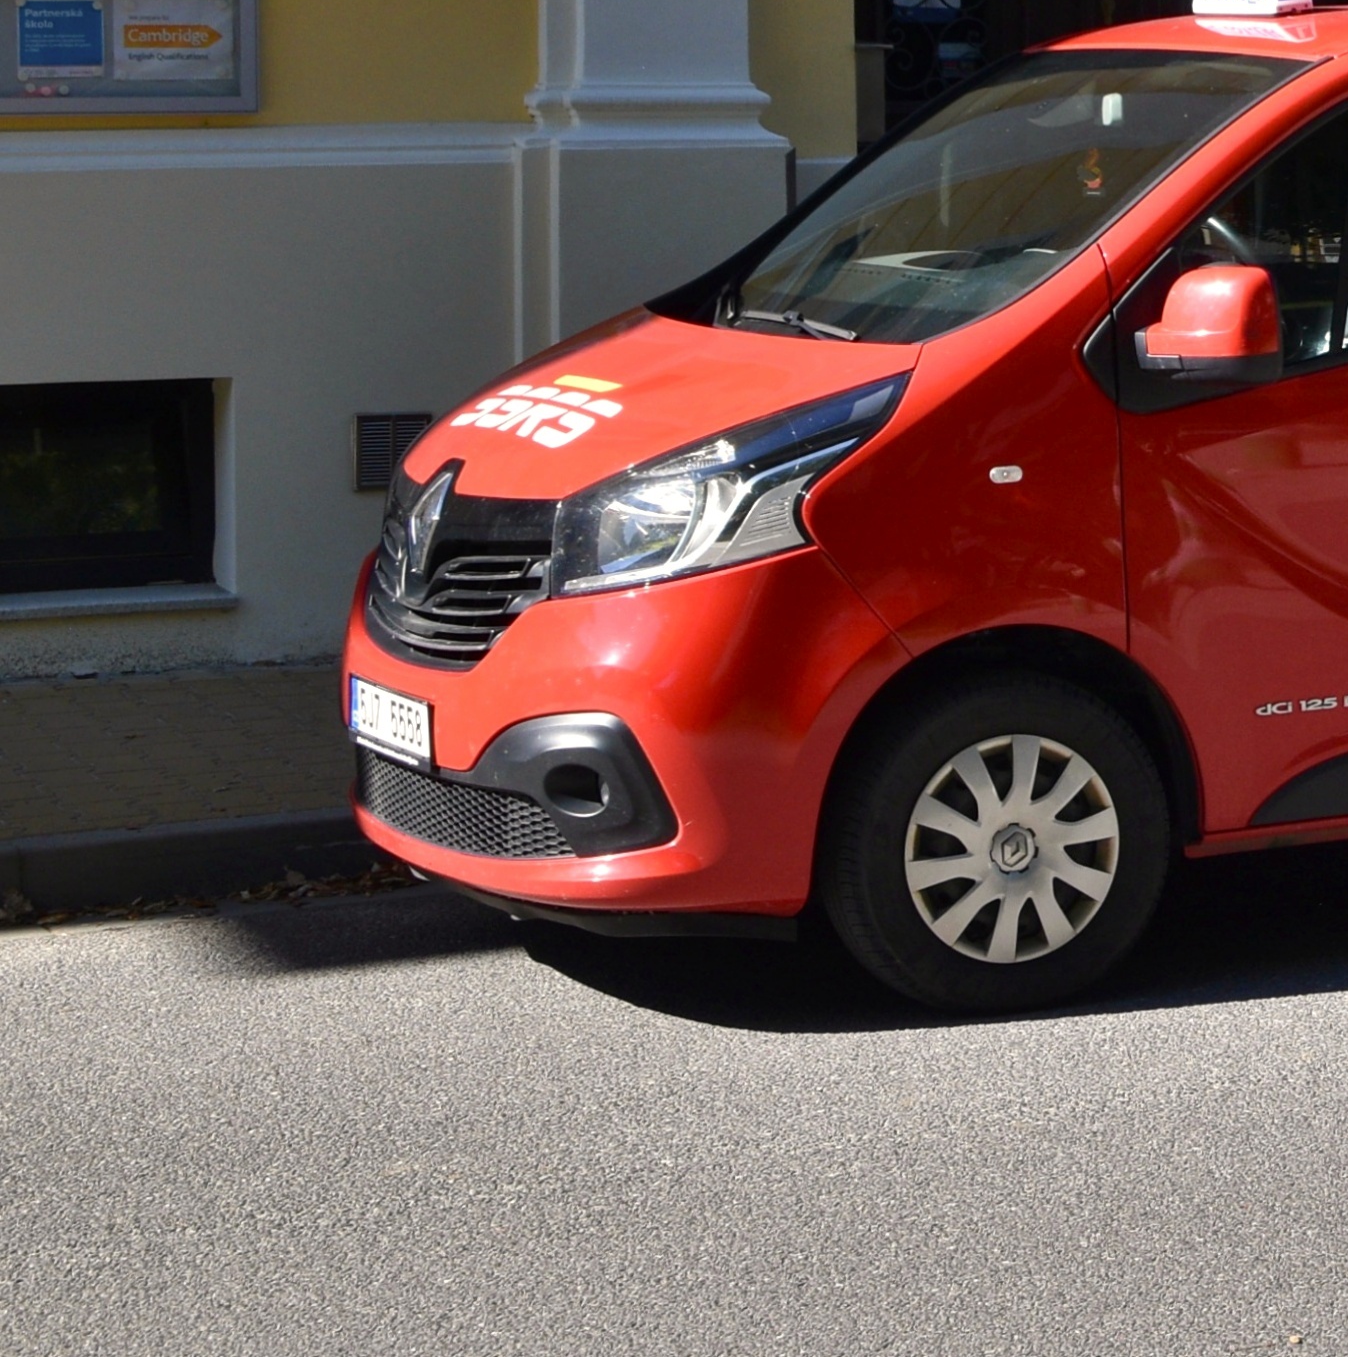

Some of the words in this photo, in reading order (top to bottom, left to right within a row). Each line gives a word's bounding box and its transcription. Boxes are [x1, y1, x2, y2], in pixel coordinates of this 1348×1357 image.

[24, 8, 84, 18] Partnerská
[24, 19, 54, 29] škola
[127, 28, 209, 46] Cambridge
[128, 52, 155, 62] English
[156, 52, 209, 62] Qualifications
[1255, 702, 1293, 716] dCi
[1299, 697, 1338, 712] 125
[390, 699, 423, 747] 5558
